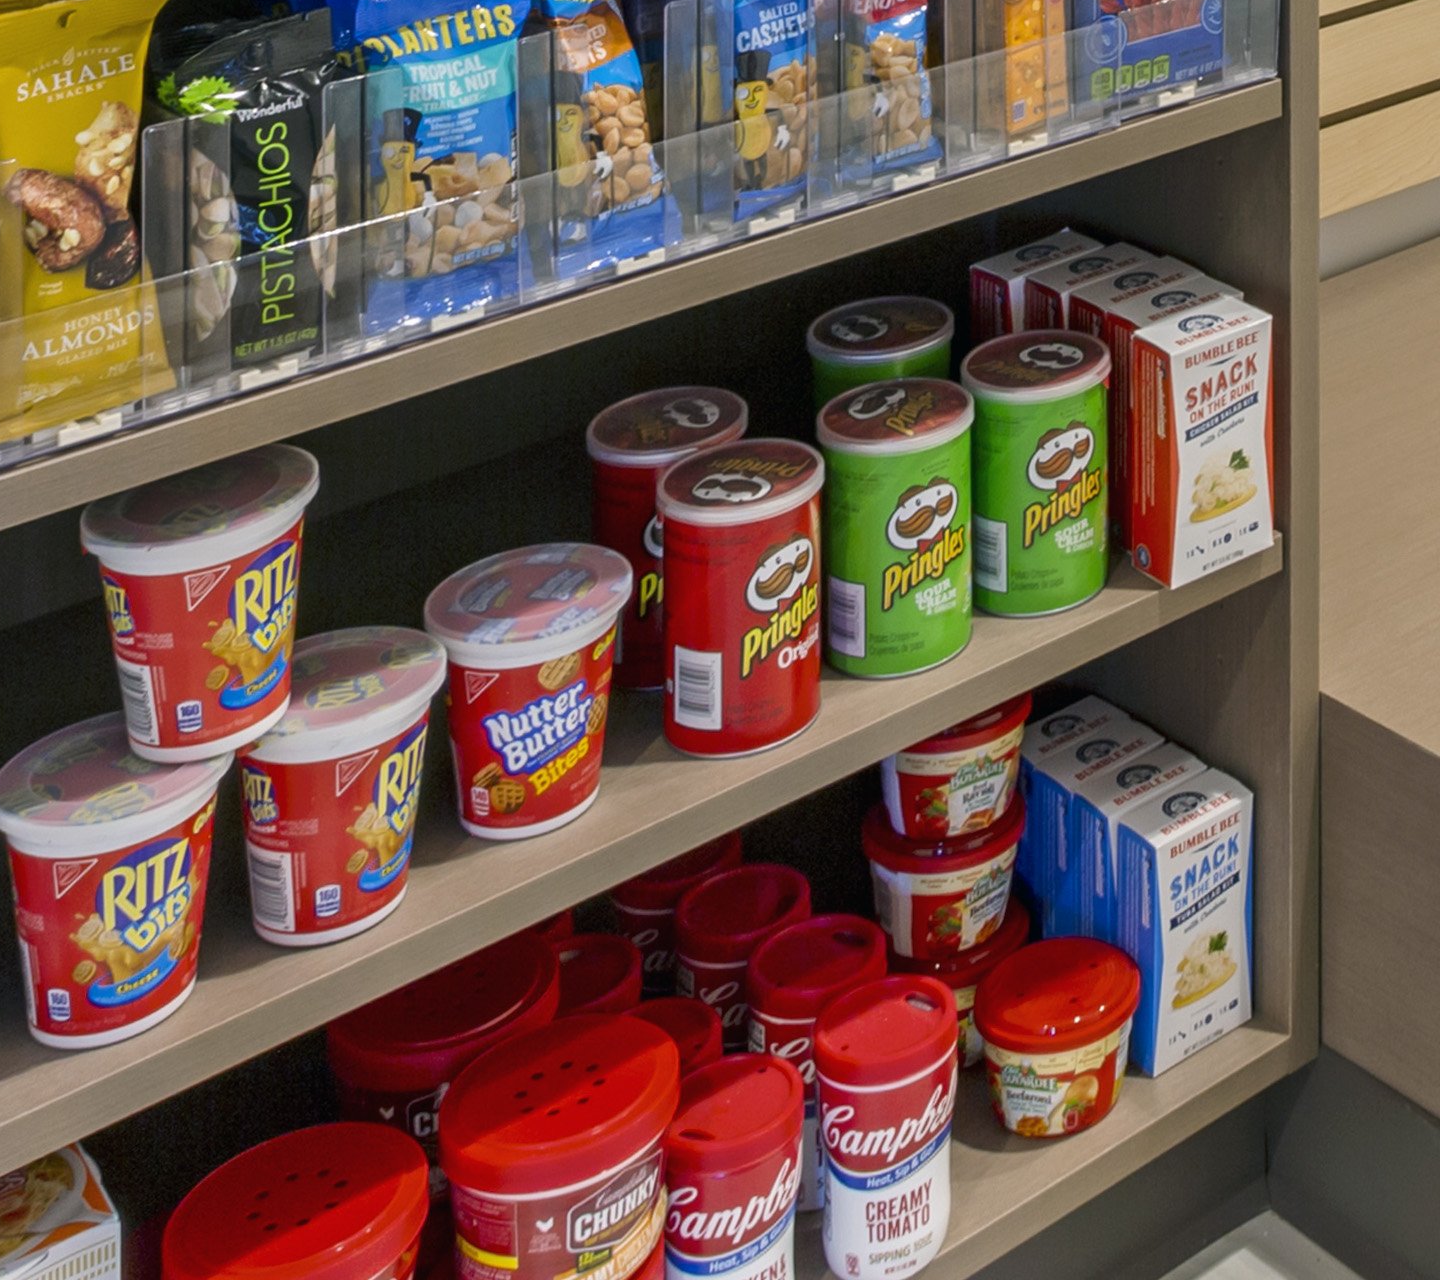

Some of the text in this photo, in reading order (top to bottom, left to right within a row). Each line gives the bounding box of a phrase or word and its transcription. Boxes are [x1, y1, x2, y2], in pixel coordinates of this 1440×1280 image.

[364, 5, 516, 58] PLANTERS
[758, 1, 799, 23] SALTED
[16, 53, 136, 103] SAHALE
[409, 61, 484, 85] TROPICAL
[236, 96, 304, 123] Wonderful
[257, 121, 294, 324] PISTACHIOS
[21, 306, 155, 363] ALMONDS
[63, 306, 123, 333] HONEY
[1184, 331, 1260, 369] BUMBLE BEE
[1186, 353, 1258, 412] SNACK
[233, 543, 298, 637] RITZ
[882, 523, 965, 612] Pringles
[740, 582, 819, 680] Pringles
[486, 681, 585, 745] Nutter
[502, 703, 592, 774] Butter
[529, 740, 590, 796] Bites
[100, 841, 191, 930] RITZ
[1170, 833, 1239, 901] SNACK
[126, 883, 191, 952] bits
[116, 968, 161, 996] Cheese
[574, 1167, 660, 1242] CHUNKY
[865, 1179, 933, 1224] CREAMY
[867, 1203, 931, 1243] TOMATO
[868, 1246, 911, 1265] SIPPING
